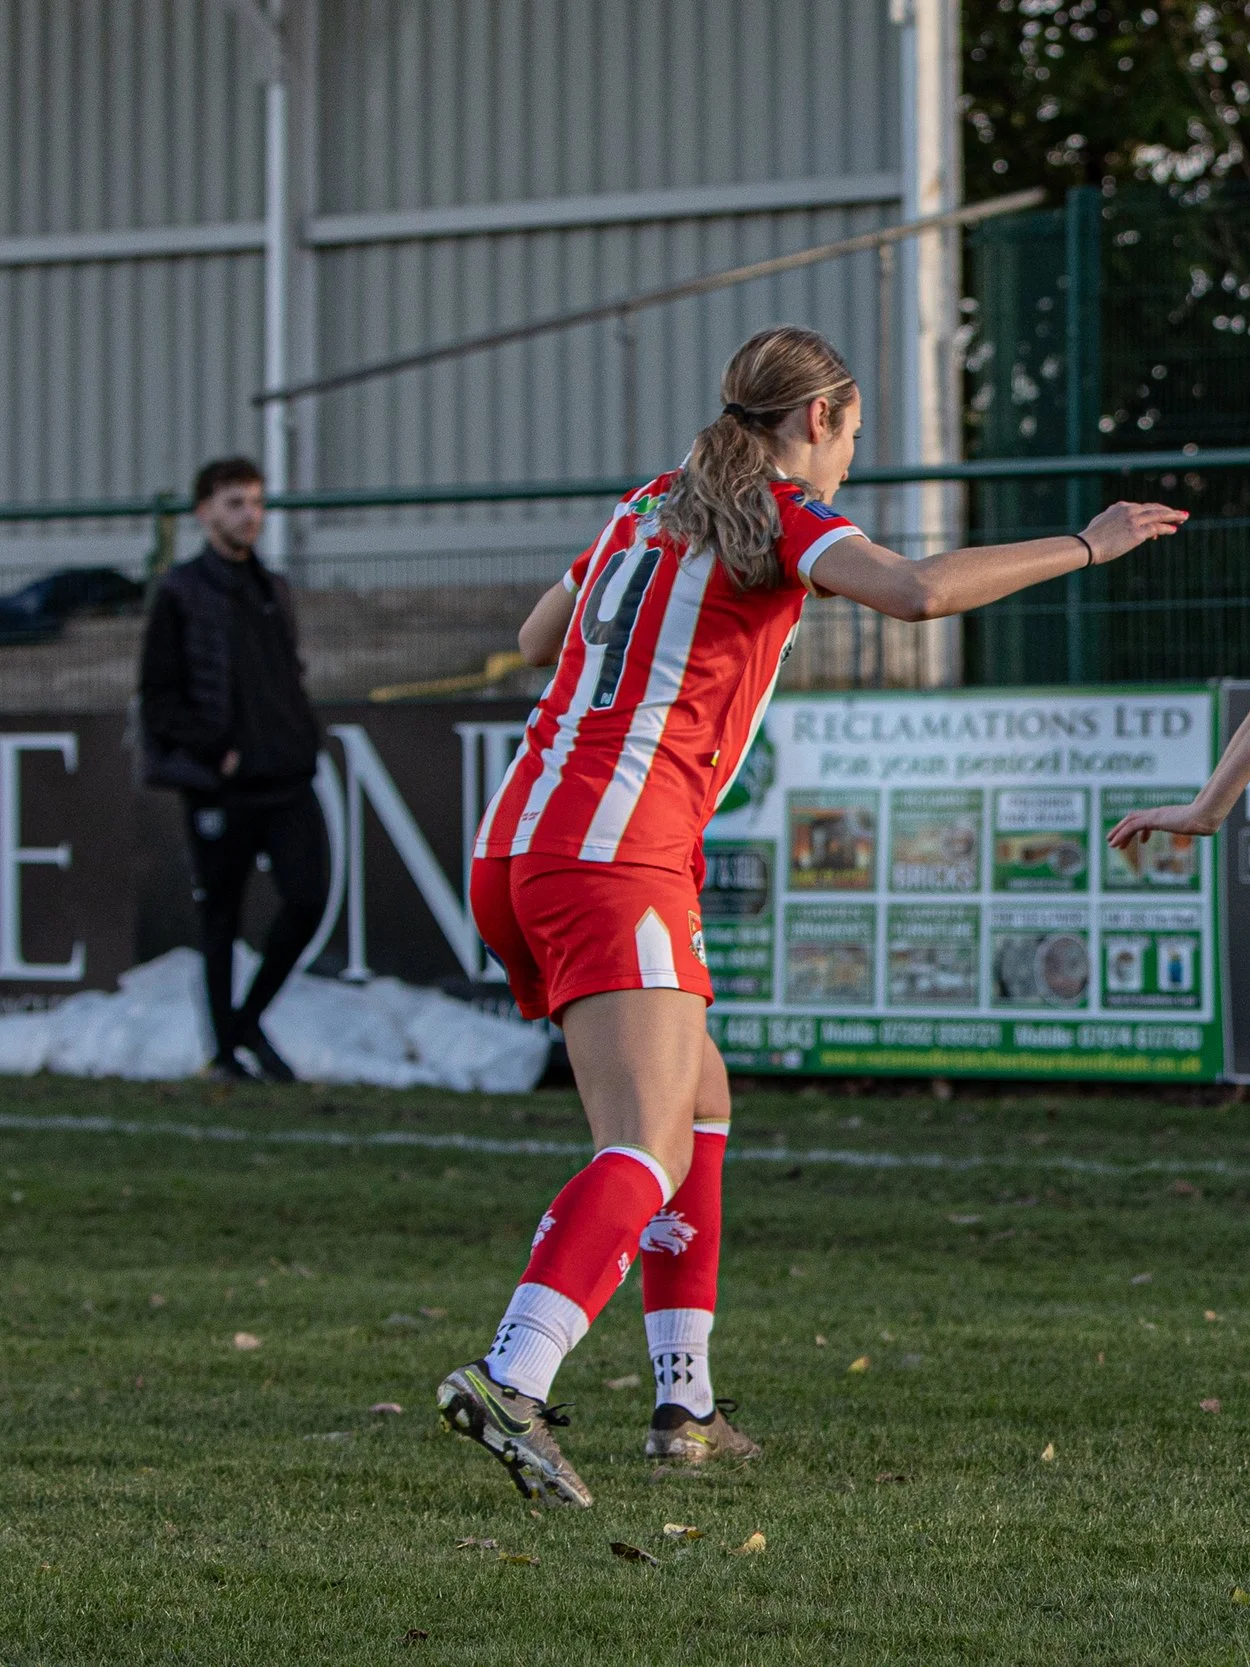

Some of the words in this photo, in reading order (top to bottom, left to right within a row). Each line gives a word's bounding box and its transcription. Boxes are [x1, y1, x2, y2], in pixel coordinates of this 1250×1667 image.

[793, 706, 1098, 744] RECLAMATIONS
[1115, 703, 1193, 739] LTD
[1069, 746, 1156, 776] home
